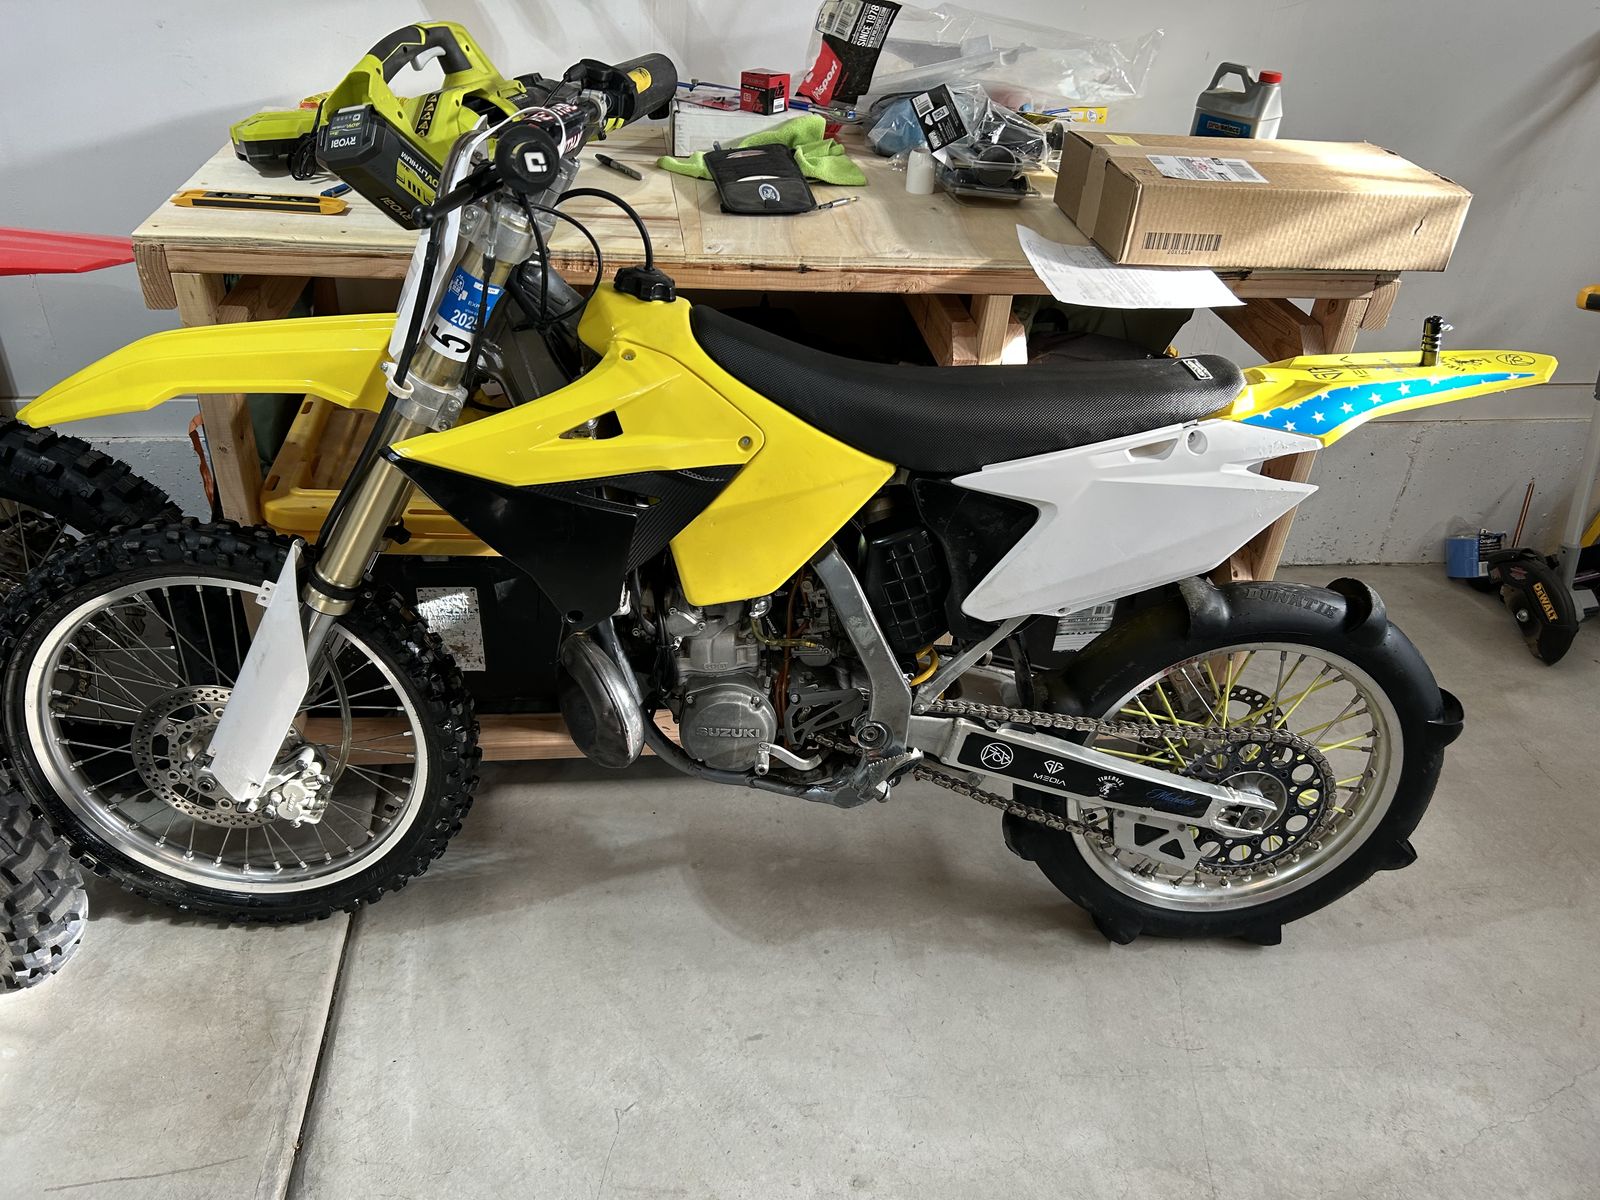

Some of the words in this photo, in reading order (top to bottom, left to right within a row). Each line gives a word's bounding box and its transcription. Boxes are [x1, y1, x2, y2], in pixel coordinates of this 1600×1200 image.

[857, 25, 872, 47] SINCE
[866, 4, 880, 24] 1978
[330, 136, 356, 149] RYOBI
[430, 323, 471, 353] 5
[696, 727, 760, 738] SUZUKI
[1033, 772, 1066, 787] MEDIA
